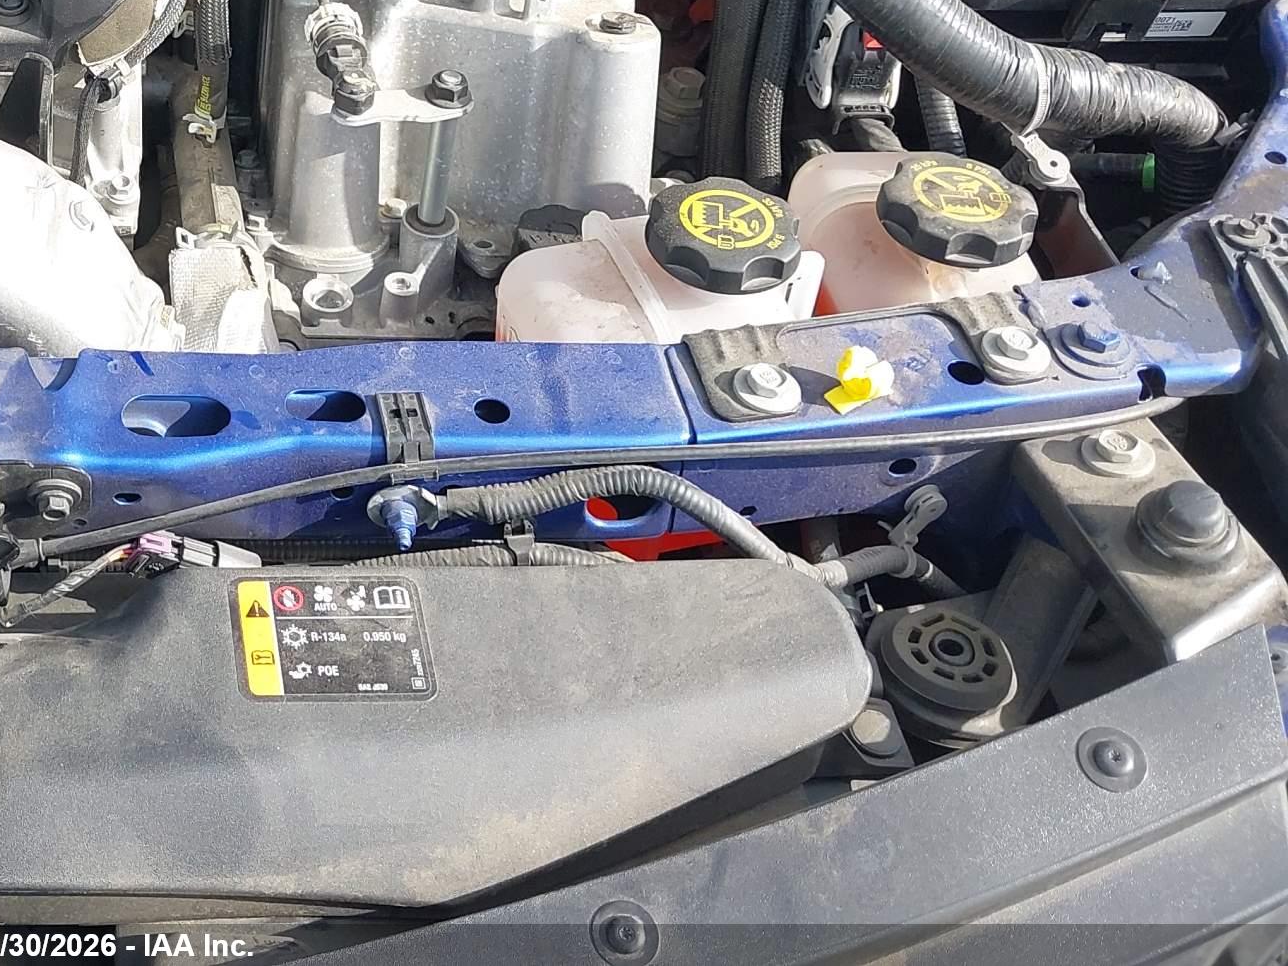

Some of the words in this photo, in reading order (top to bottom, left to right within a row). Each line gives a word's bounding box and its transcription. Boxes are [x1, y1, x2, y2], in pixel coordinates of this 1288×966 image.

[314, 603, 337, 612] AUTO
[311, 631, 347, 642] R-134a
[392, 630, 407, 643] kg
[318, 666, 340, 677] POE
